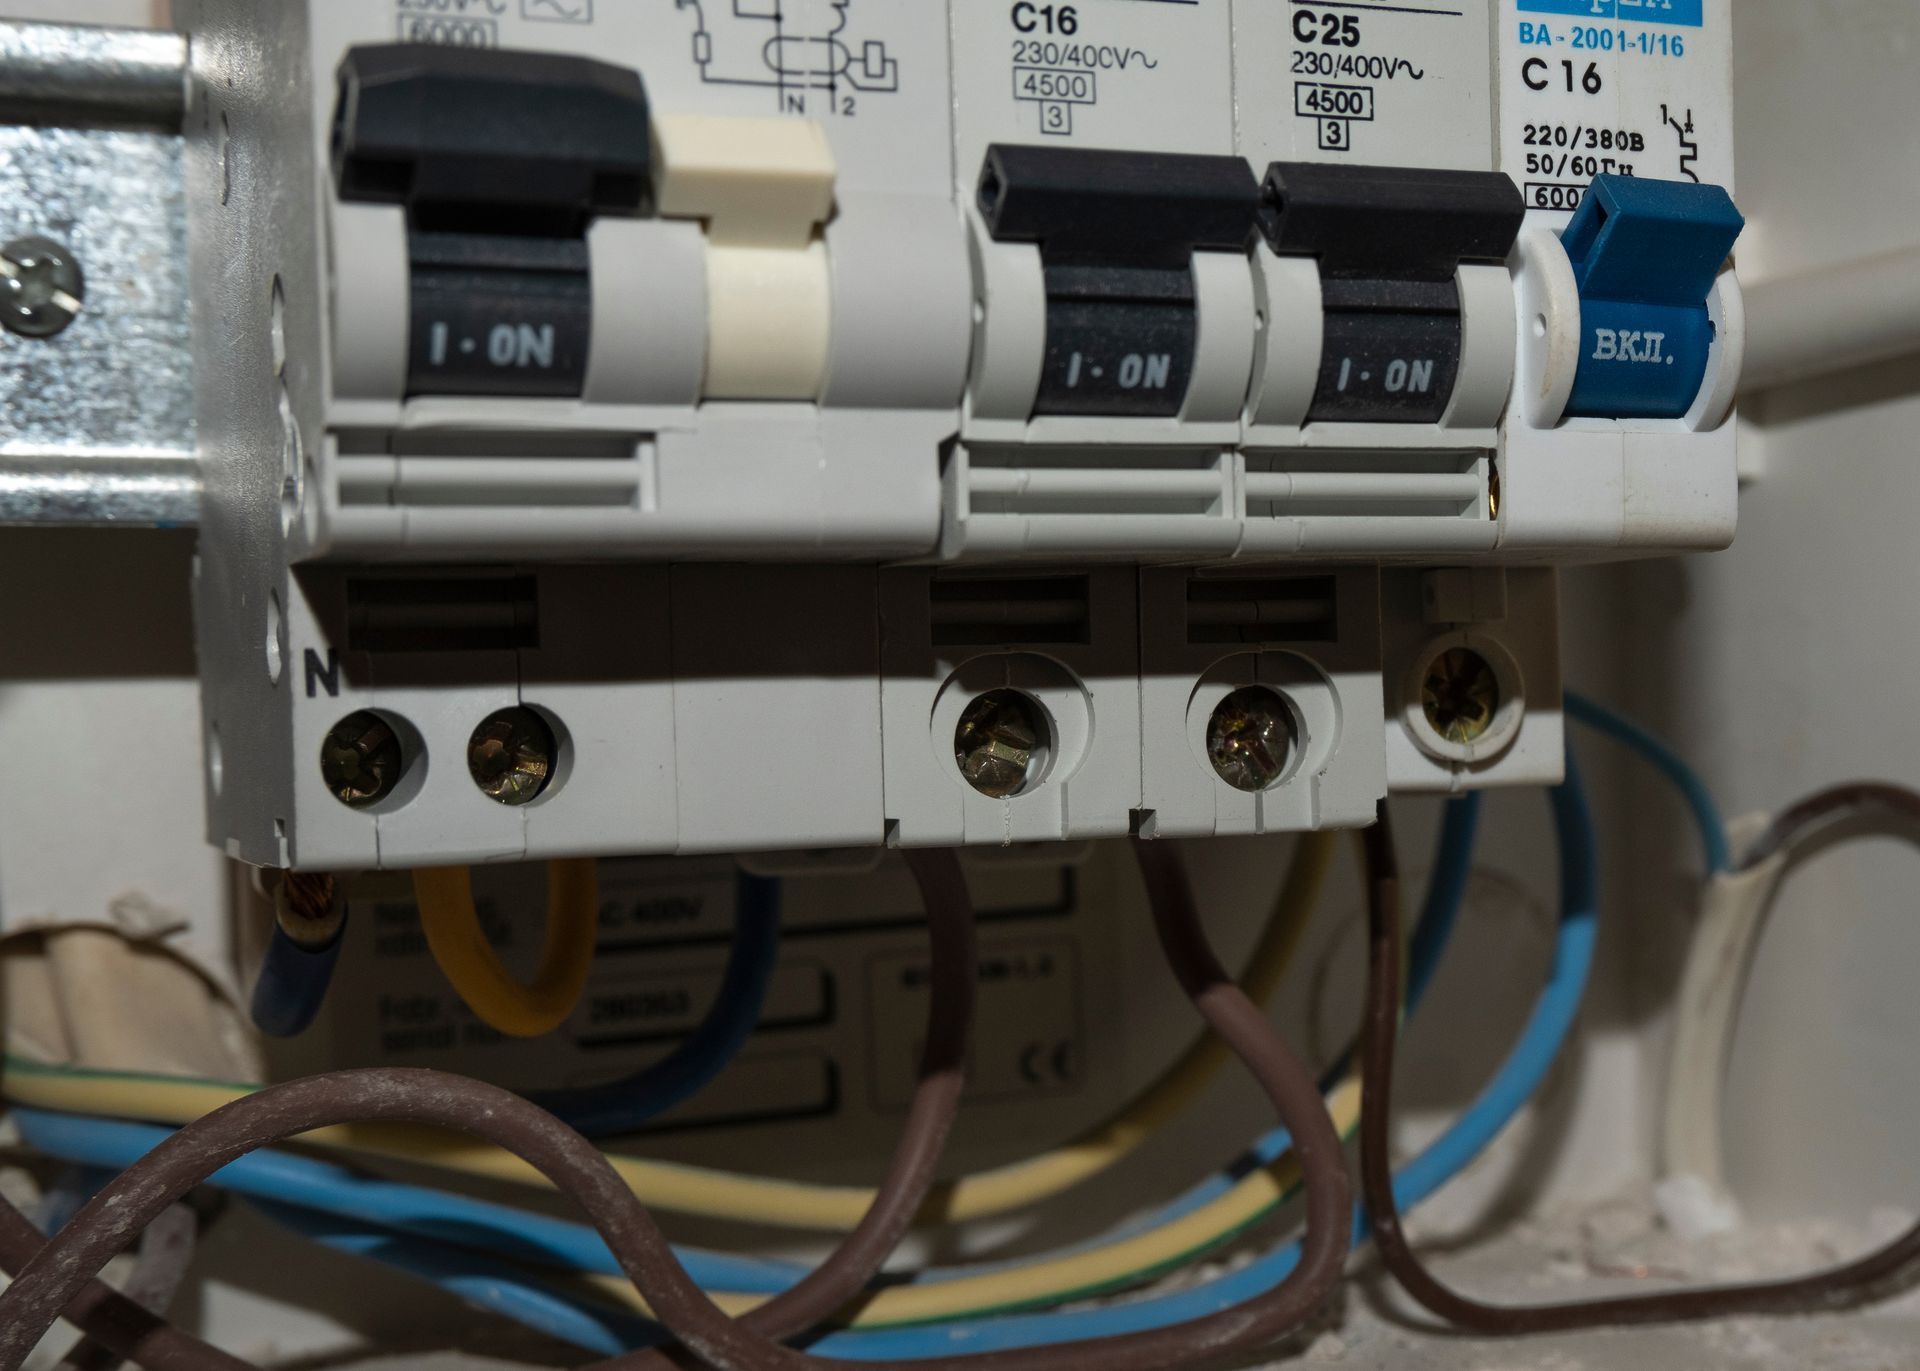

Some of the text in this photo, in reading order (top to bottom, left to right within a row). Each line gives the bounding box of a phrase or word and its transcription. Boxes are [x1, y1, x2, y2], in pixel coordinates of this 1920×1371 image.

[1011, 1, 1077, 35] C16
[1292, 9, 1360, 47] C25
[1023, 73, 1087, 98] 4500
[1306, 88, 1363, 114] 4500
[1048, 105, 1062, 128] 3
[1326, 121, 1341, 145] 3
[303, 647, 340, 698] N
